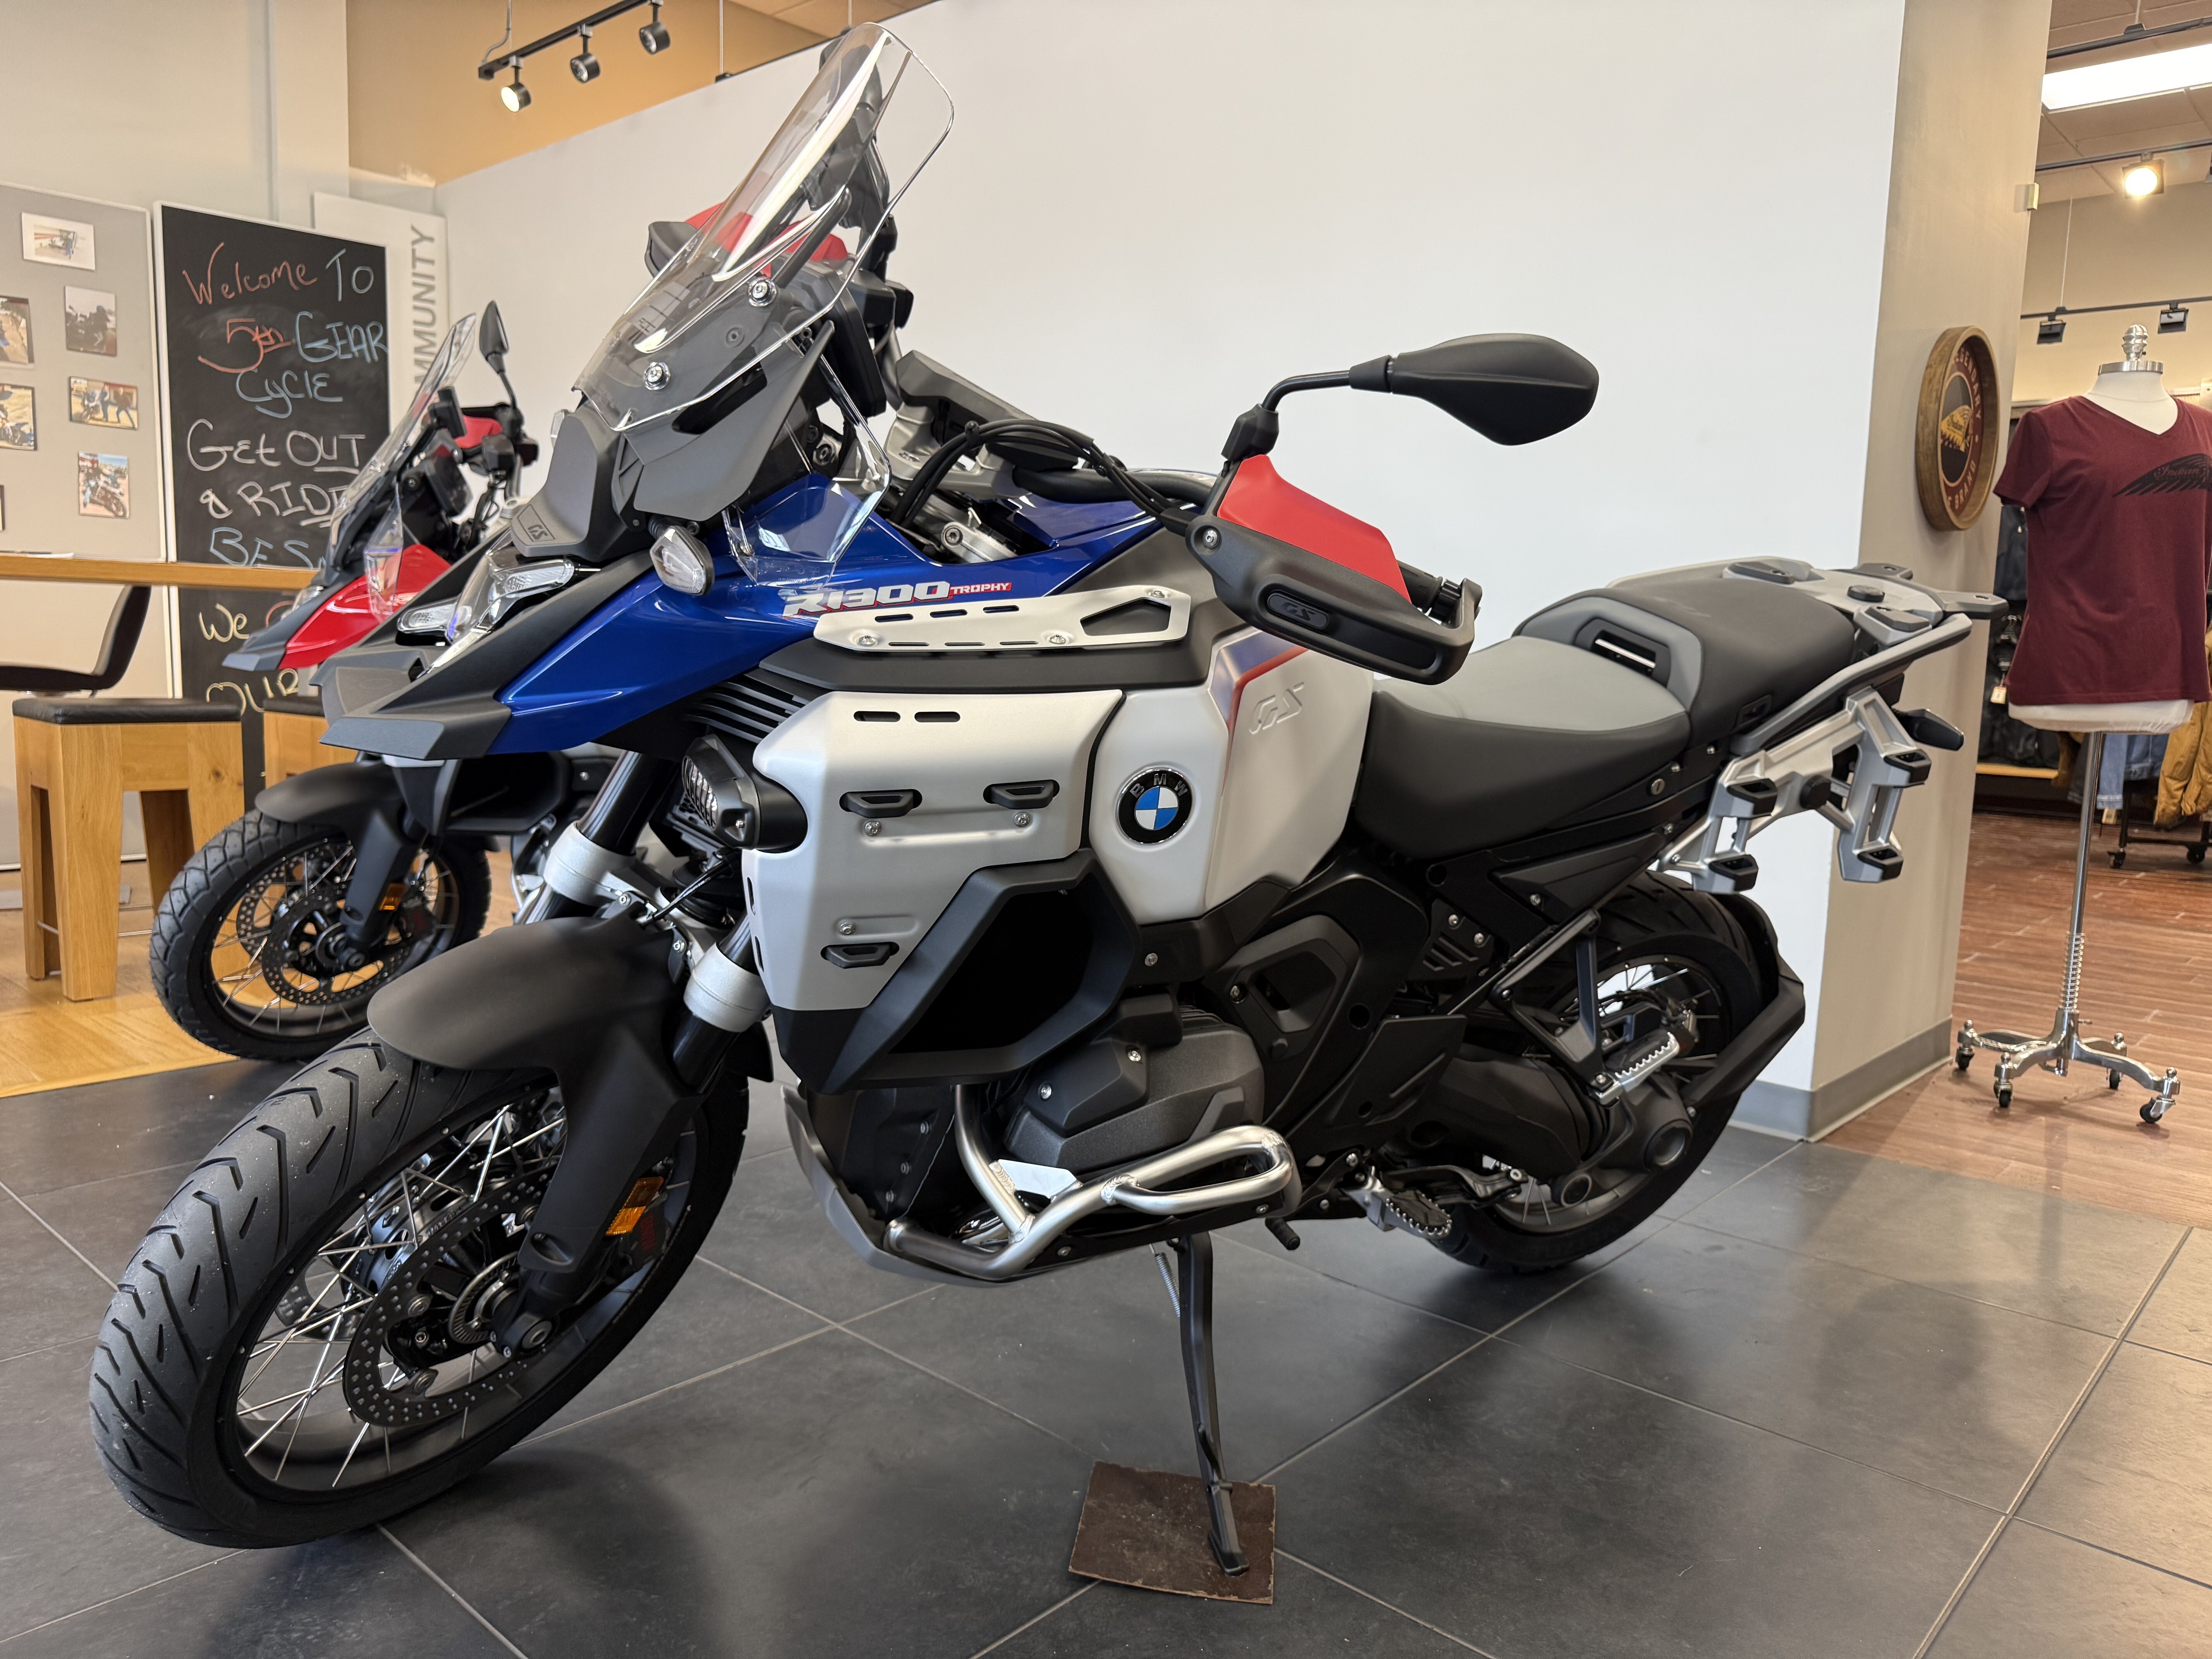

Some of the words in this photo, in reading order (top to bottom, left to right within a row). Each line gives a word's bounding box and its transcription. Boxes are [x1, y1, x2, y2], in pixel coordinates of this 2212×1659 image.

[183, 242, 318, 304] Welcome
[295, 311, 388, 363] GEAR
[527, 524, 548, 540] GS
[950, 582, 1010, 594] TROPHY
[1281, 601, 1317, 621] GS
[1130, 773, 1188, 798] BMW
